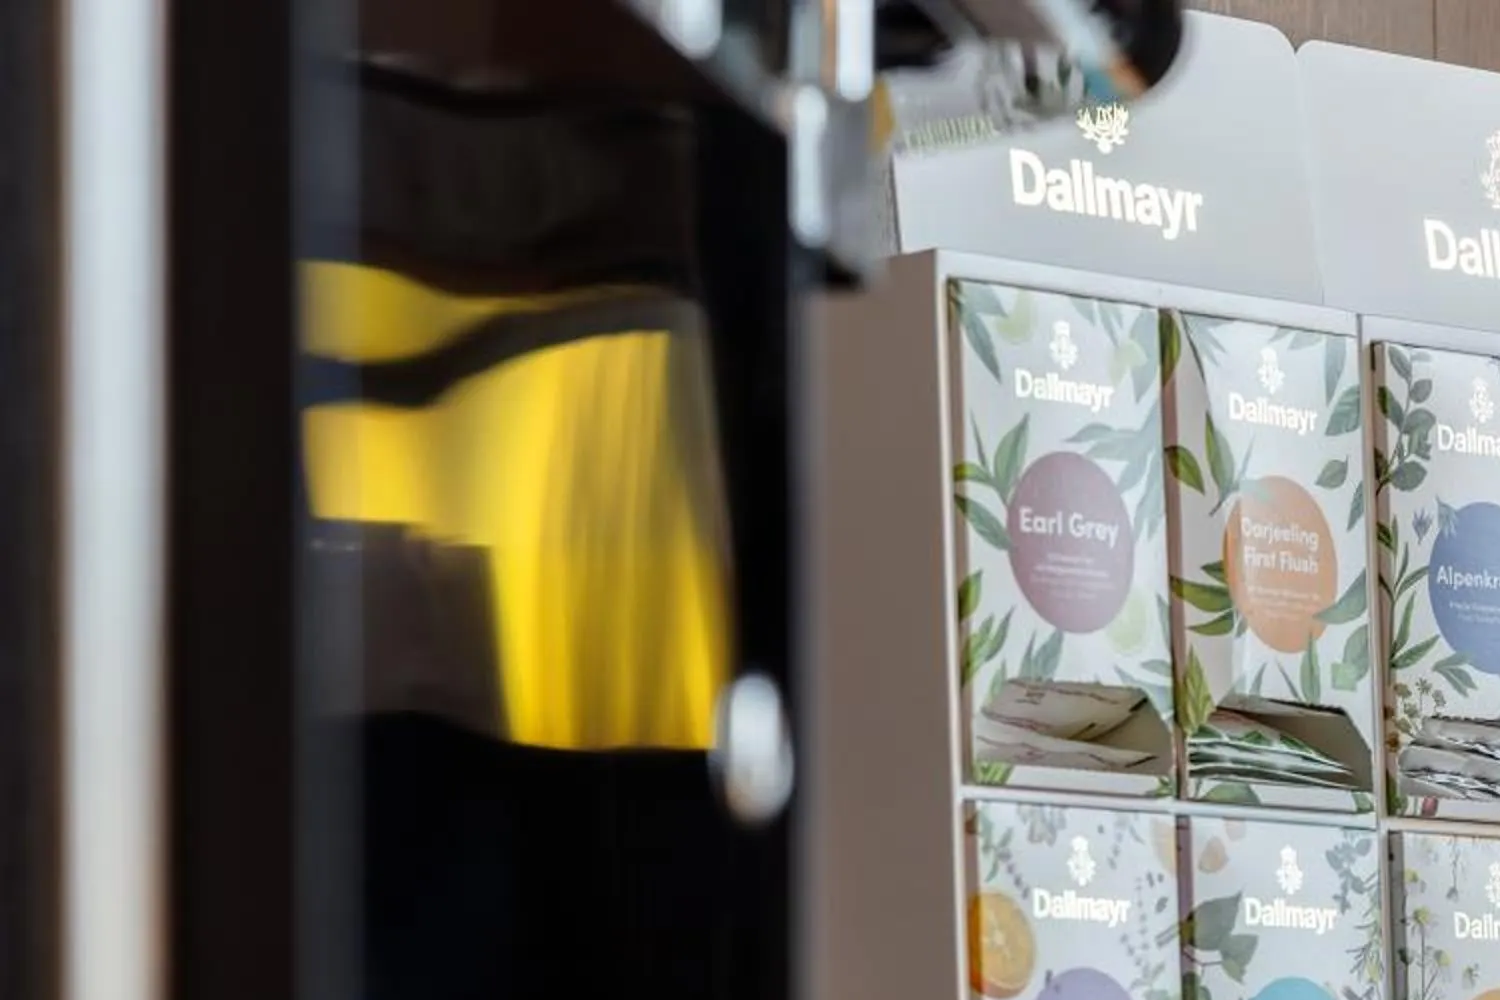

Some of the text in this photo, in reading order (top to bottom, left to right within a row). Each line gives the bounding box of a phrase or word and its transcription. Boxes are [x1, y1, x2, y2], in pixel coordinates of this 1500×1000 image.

[1009, 148, 1202, 241] Dallmayr
[1015, 369, 1114, 413] Dallmayr
[1229, 391, 1318, 436] Dallmayr
[1020, 507, 1120, 548] Earl Grey
[1241, 516, 1320, 551] Darjeeling
[1243, 545, 1319, 576] First Flush
[1032, 888, 1131, 927] Dallmayr
[1245, 897, 1338, 934] Dallmayr
